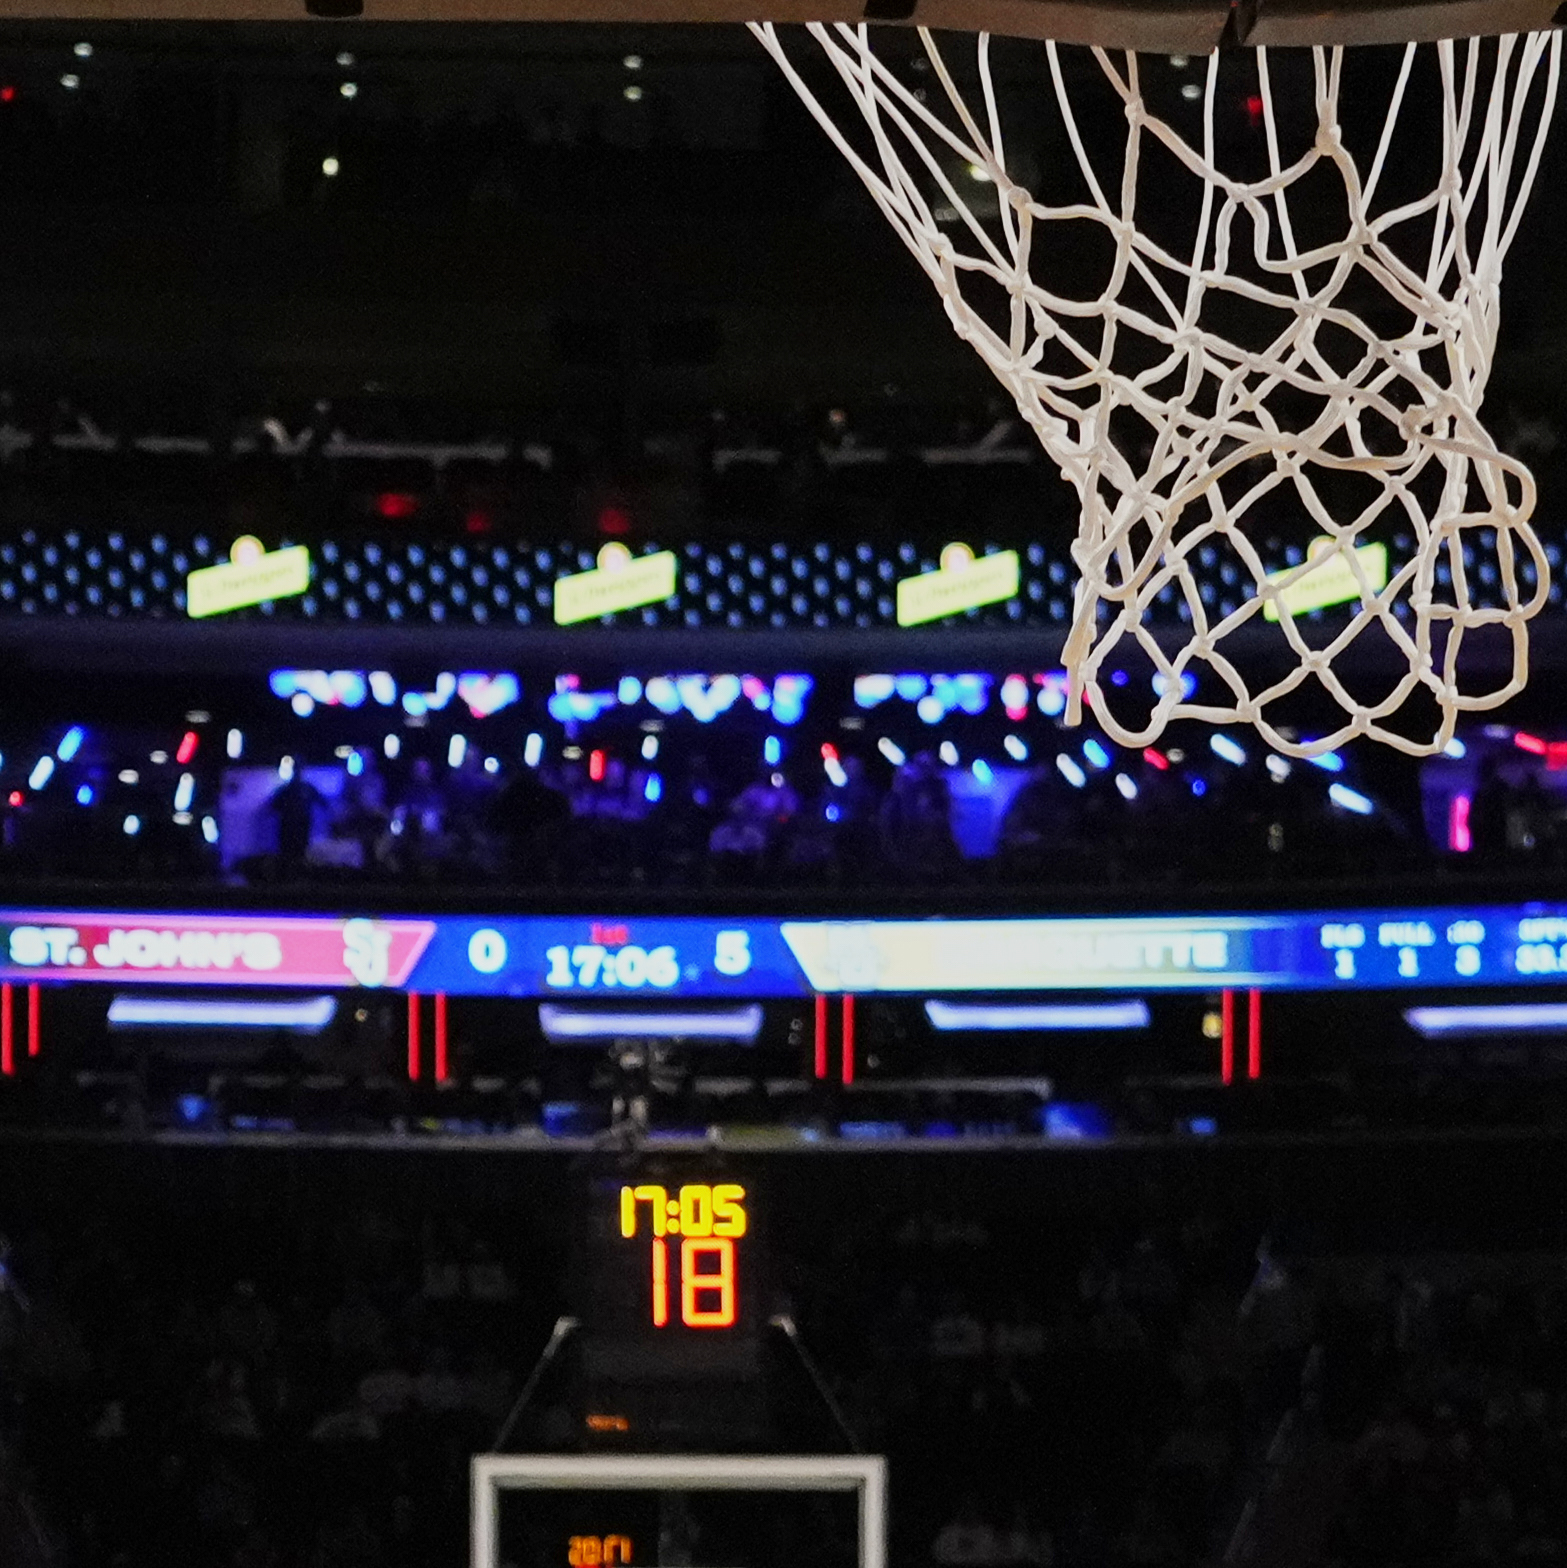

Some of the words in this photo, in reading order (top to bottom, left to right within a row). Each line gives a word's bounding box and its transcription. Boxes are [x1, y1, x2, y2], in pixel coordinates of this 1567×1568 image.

[9, 926, 87, 966] ST.
[93, 927, 282, 971] JOHN'S
[468, 928, 508, 974] 0
[545, 944, 680, 988] 17:06
[713, 930, 752, 976] 5
[620, 1184, 747, 1239] 17:05
[652, 1236, 736, 1328] 18
